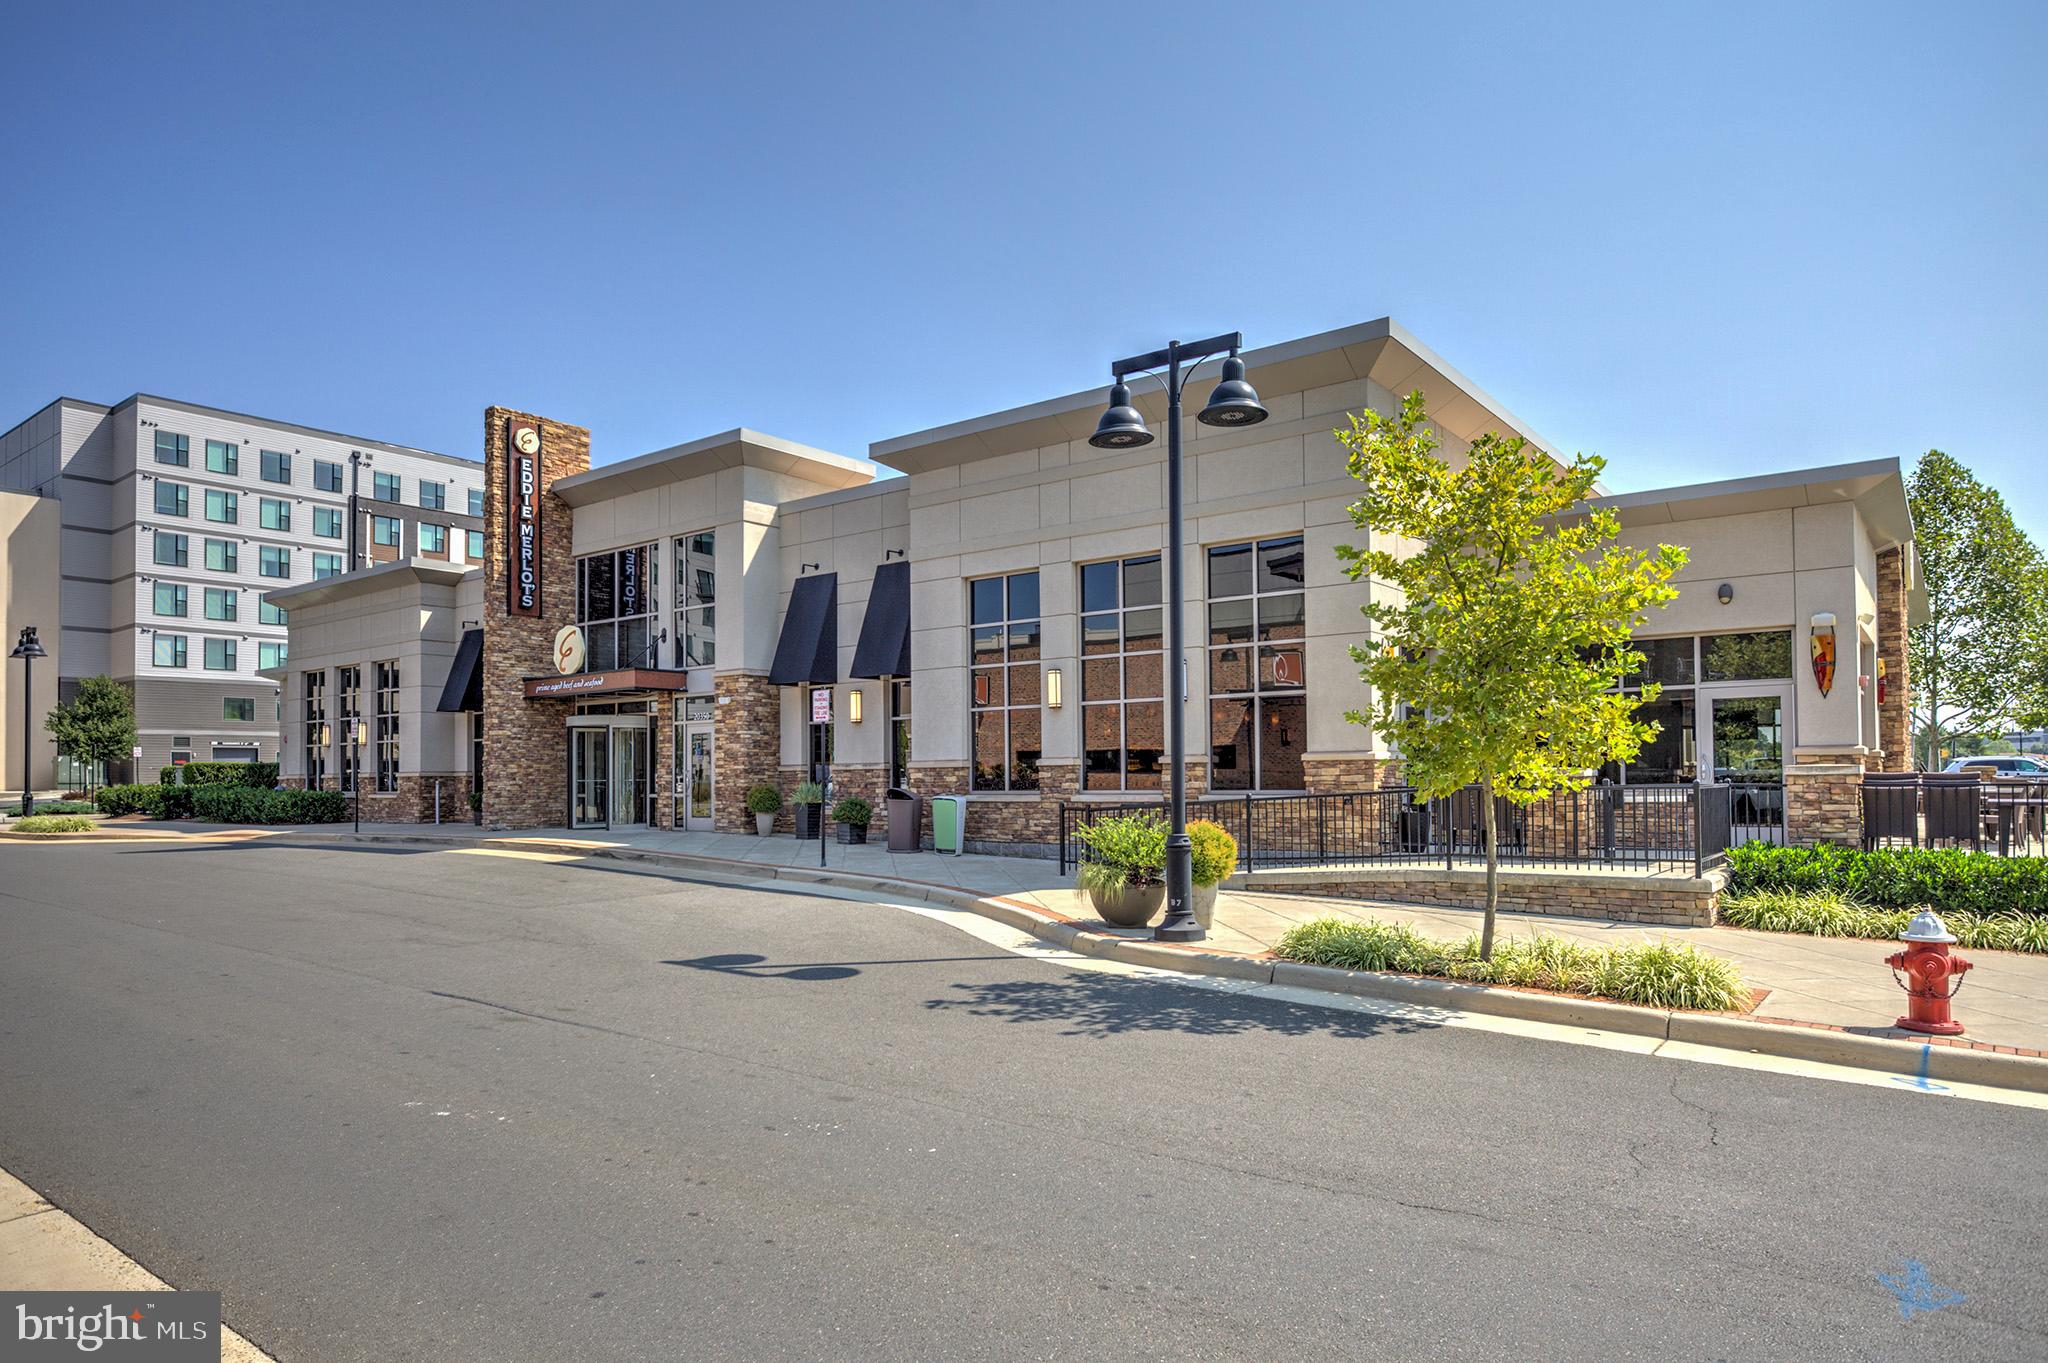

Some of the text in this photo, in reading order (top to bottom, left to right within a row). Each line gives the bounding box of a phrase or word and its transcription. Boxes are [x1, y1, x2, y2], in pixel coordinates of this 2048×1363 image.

[521, 459, 535, 608] EDDIE MERLOT'S
[536, 676, 604, 694] prime aged beef and seafood
